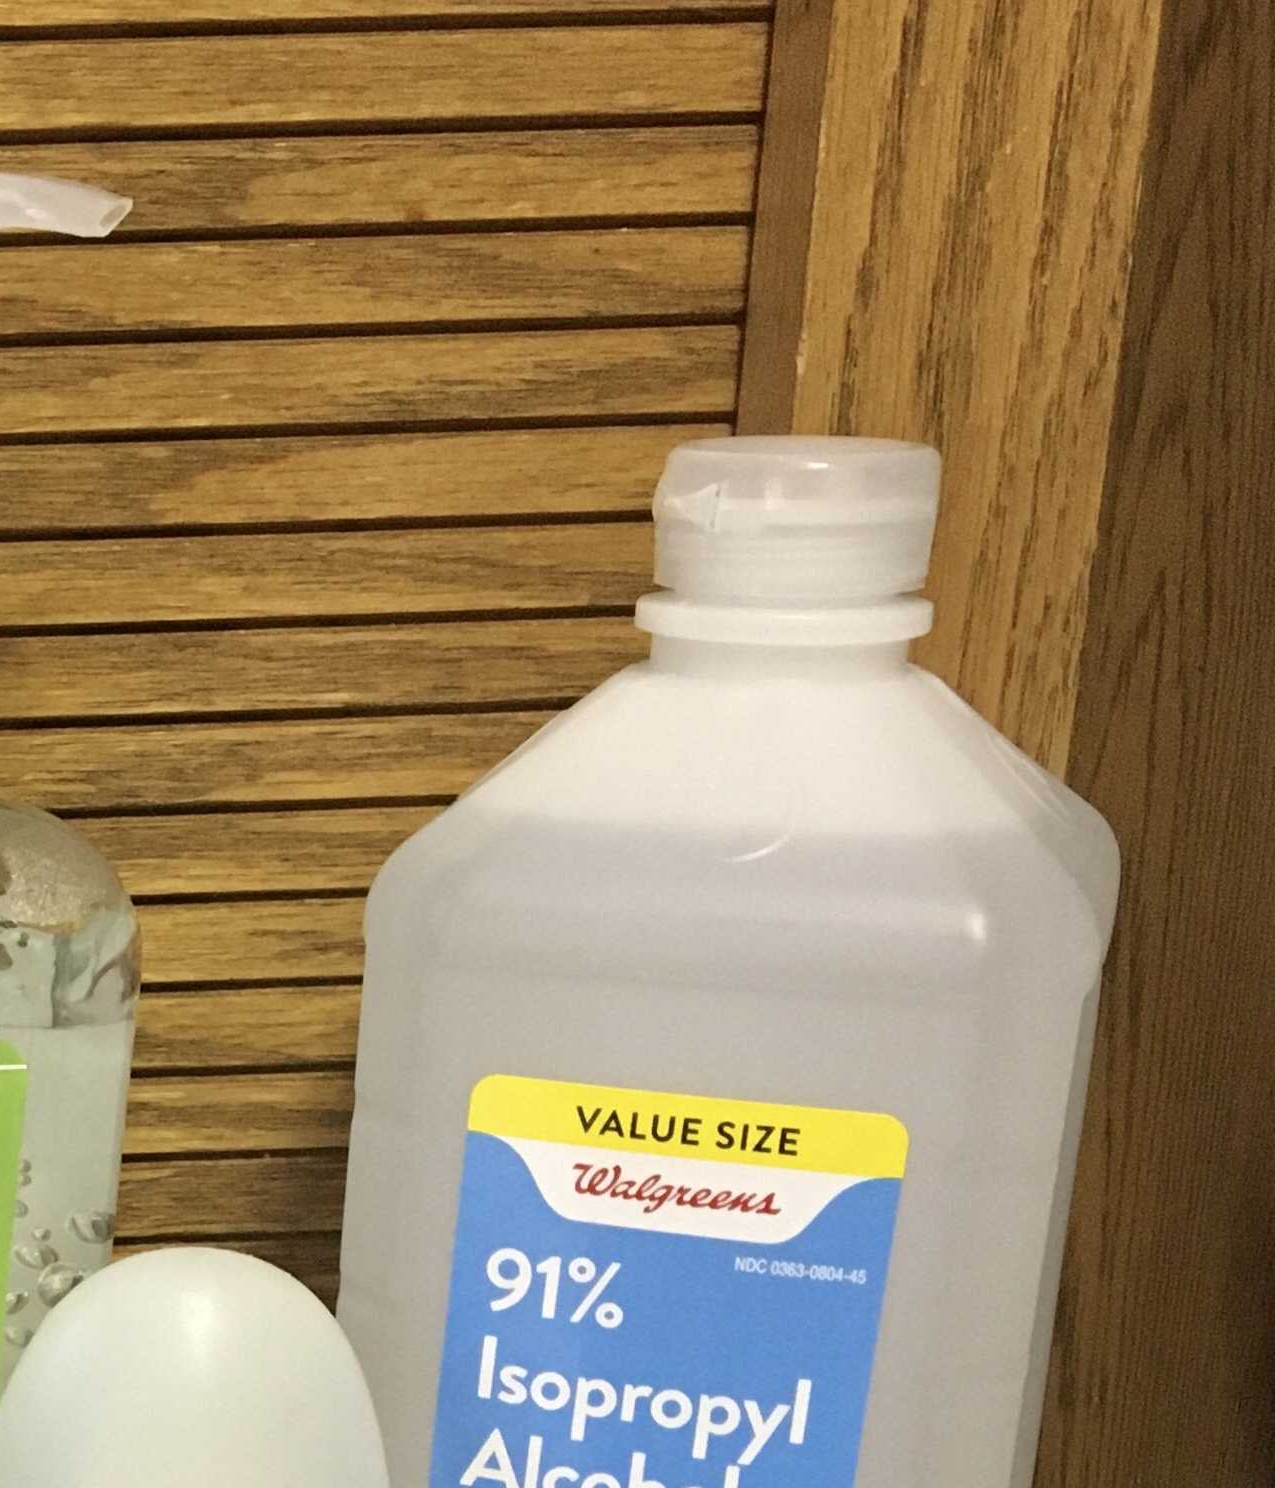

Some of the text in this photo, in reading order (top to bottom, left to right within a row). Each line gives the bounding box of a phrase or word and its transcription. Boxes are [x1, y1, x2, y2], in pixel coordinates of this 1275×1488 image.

[576, 1105, 801, 1156] VALUE SIZE
[572, 1163, 781, 1216] Walgreens
[486, 1247, 624, 1329] 91%
[734, 1256, 767, 1274] NDC
[477, 1335, 812, 1466] Isopropyl
